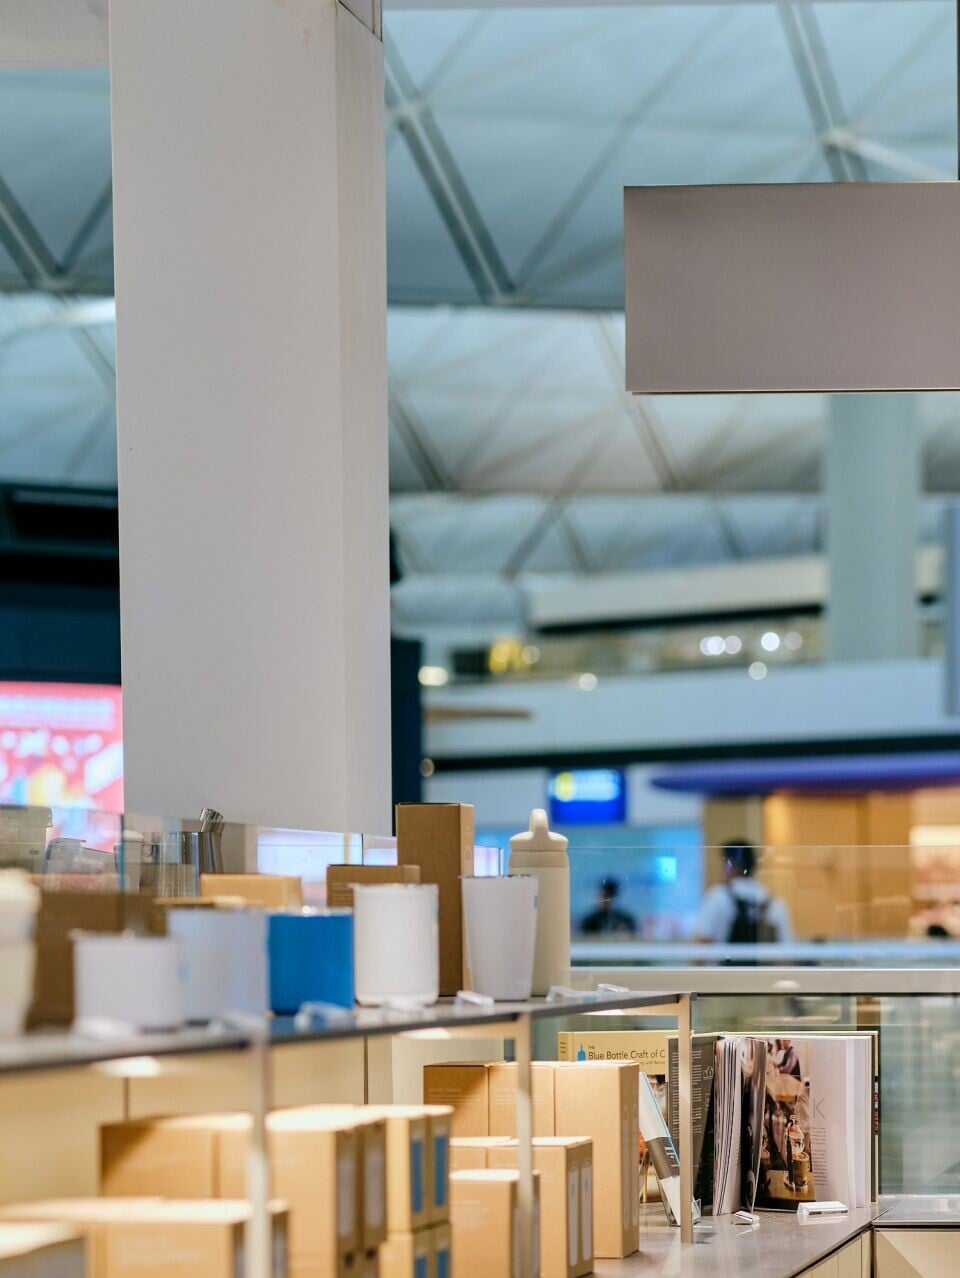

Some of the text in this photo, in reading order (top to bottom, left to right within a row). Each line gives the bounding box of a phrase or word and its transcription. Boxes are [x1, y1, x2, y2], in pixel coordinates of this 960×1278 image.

[589, 1051, 605, 1060] Blue
[607, 1051, 628, 1060] Bottle
[631, 1050, 648, 1058] Craft
[651, 1049, 658, 1058] of
[813, 1098, 826, 1118] K
